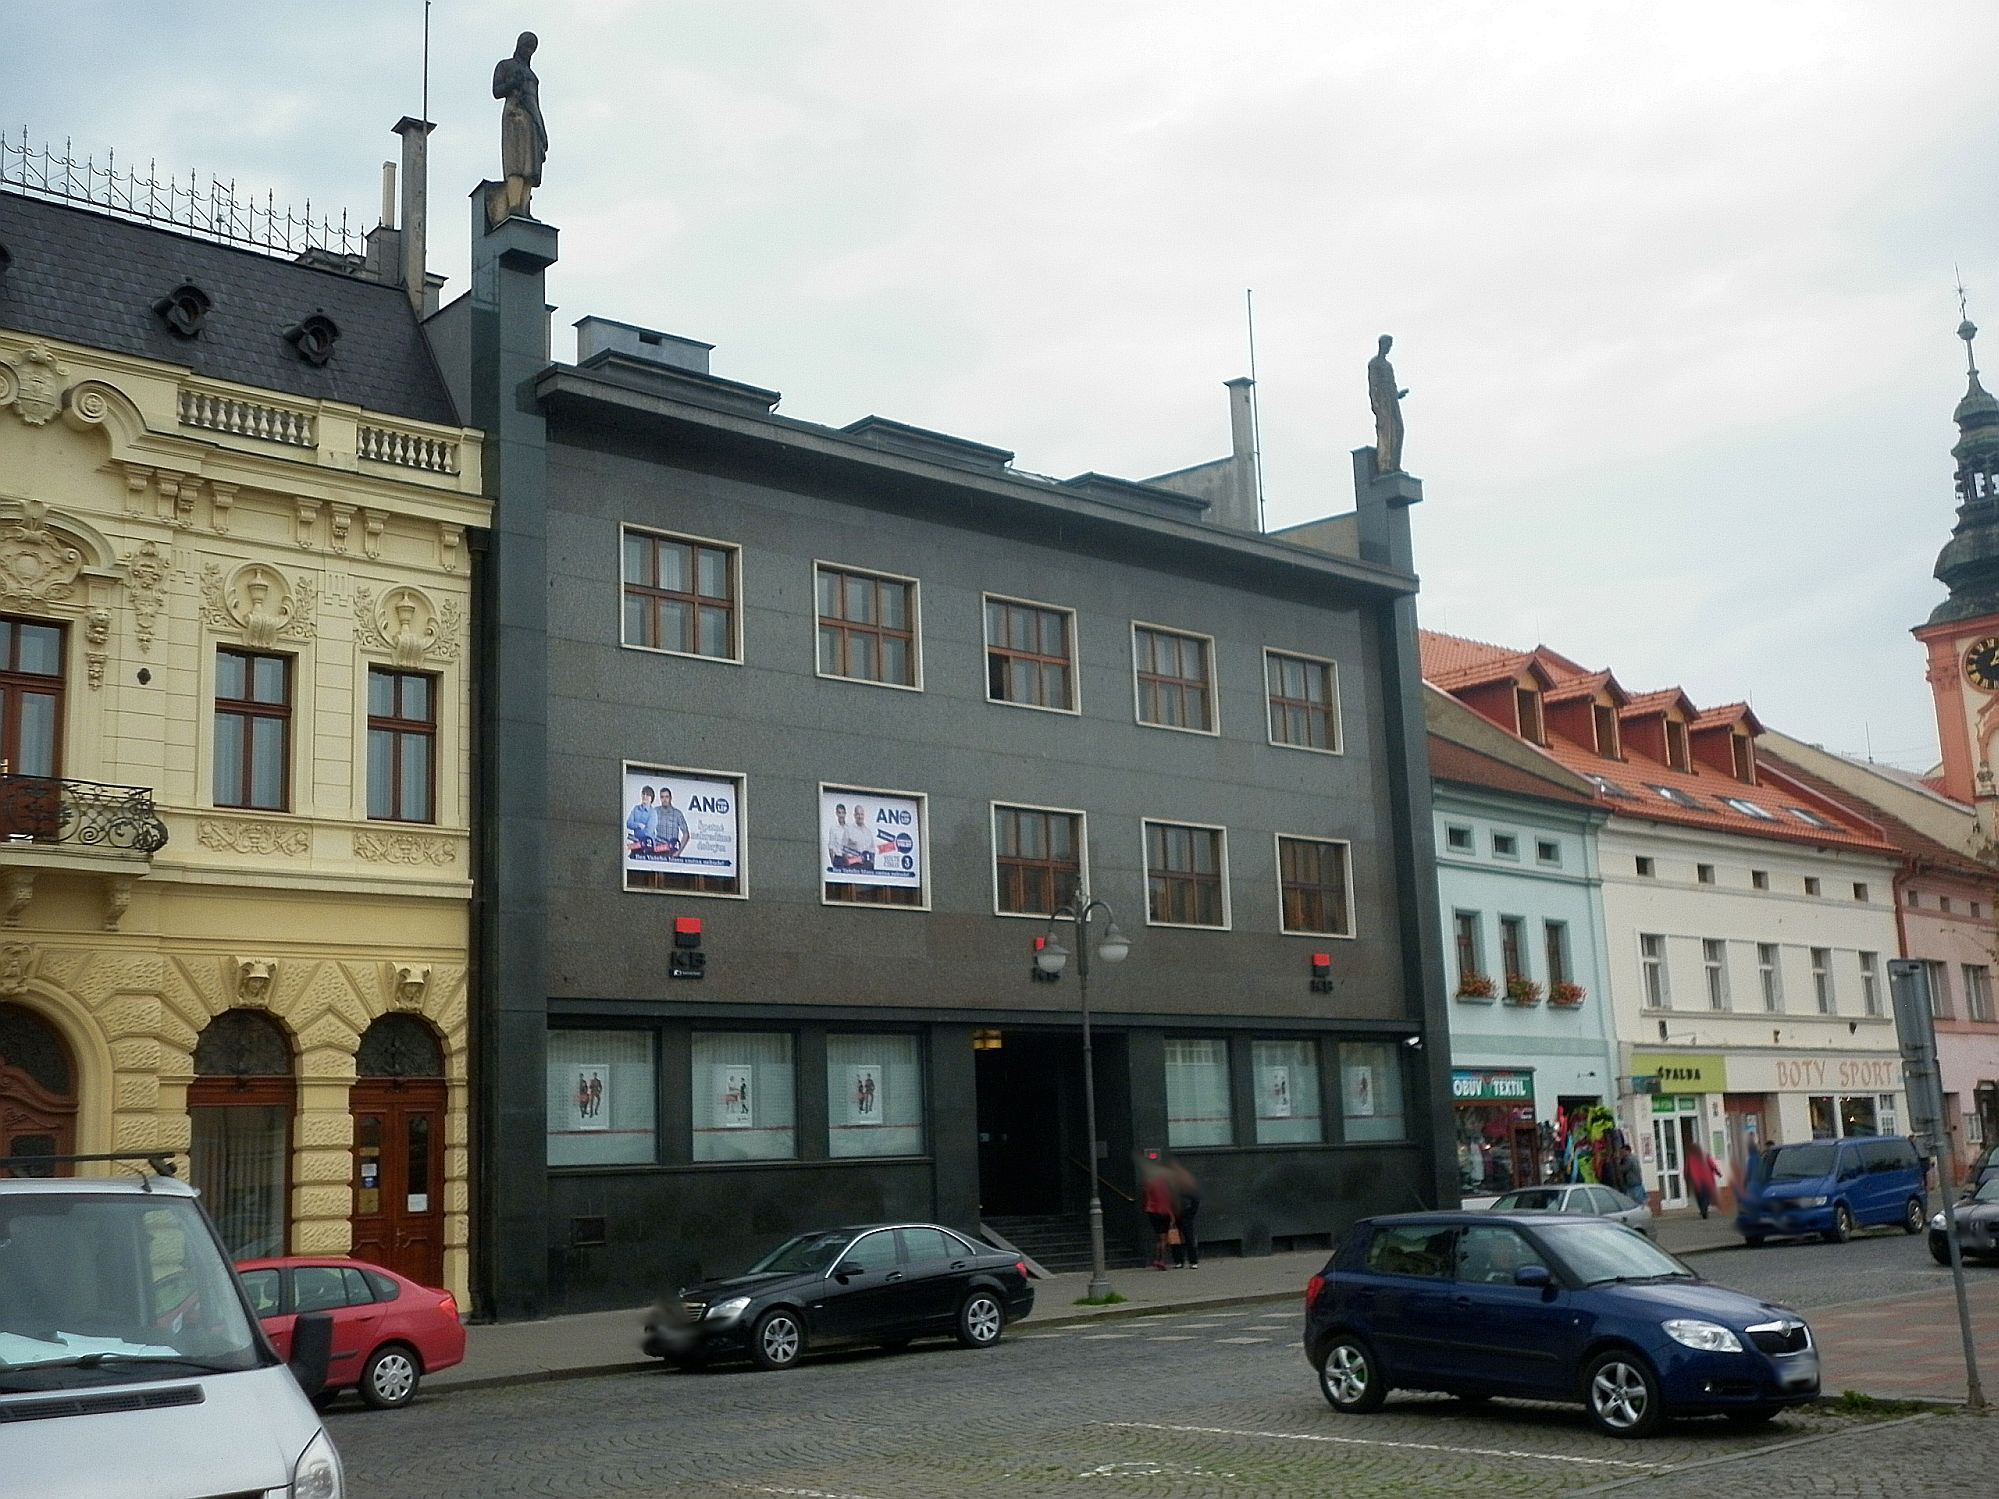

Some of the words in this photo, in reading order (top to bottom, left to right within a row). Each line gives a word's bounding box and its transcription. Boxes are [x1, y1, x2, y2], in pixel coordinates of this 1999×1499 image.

[688, 795, 729, 814] ANO
[876, 808, 911, 825] ANO
[1776, 1060, 1826, 1088] BOTY
[1839, 1061, 1893, 1088] SPORT
[1453, 1079, 1482, 1097] OBUV
[1493, 1079, 1527, 1097] TEXTIL
